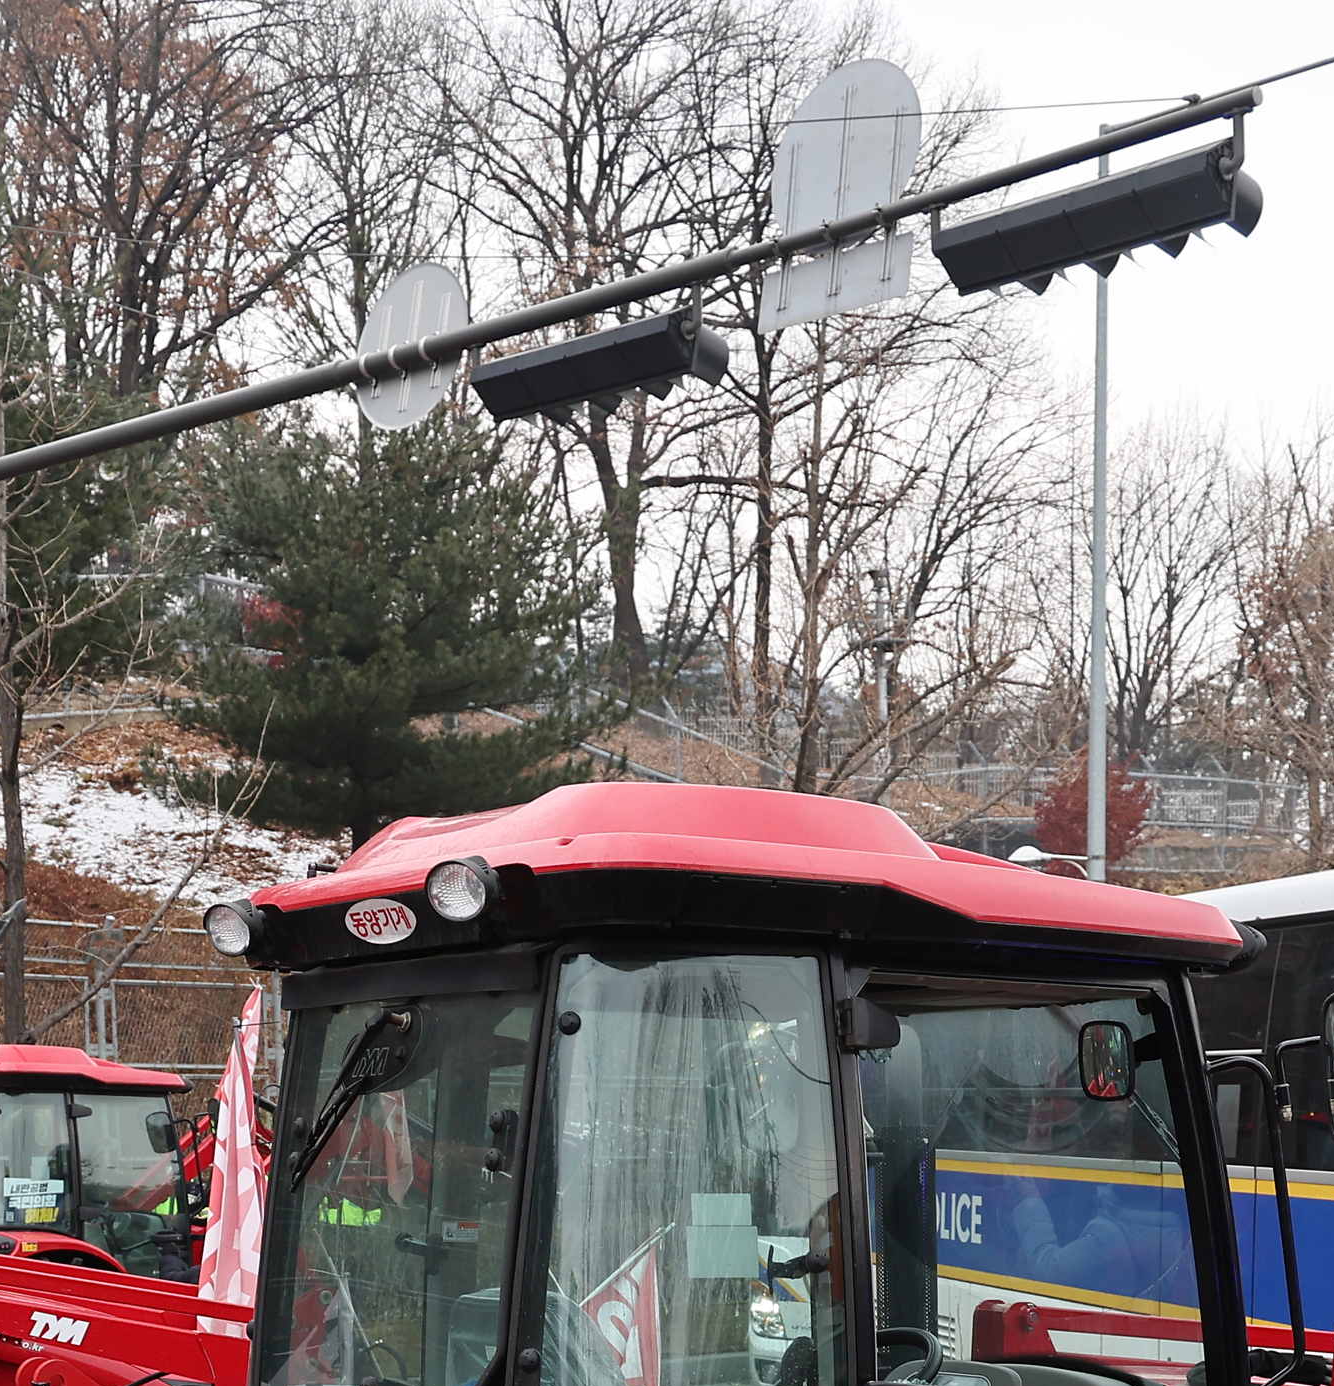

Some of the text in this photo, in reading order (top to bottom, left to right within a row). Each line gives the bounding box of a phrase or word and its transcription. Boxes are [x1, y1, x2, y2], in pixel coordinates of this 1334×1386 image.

[349, 905, 412, 937] 동양기계
[8, 1194, 57, 1210] 국민의힘
[29, 1310, 90, 1346] TYM
